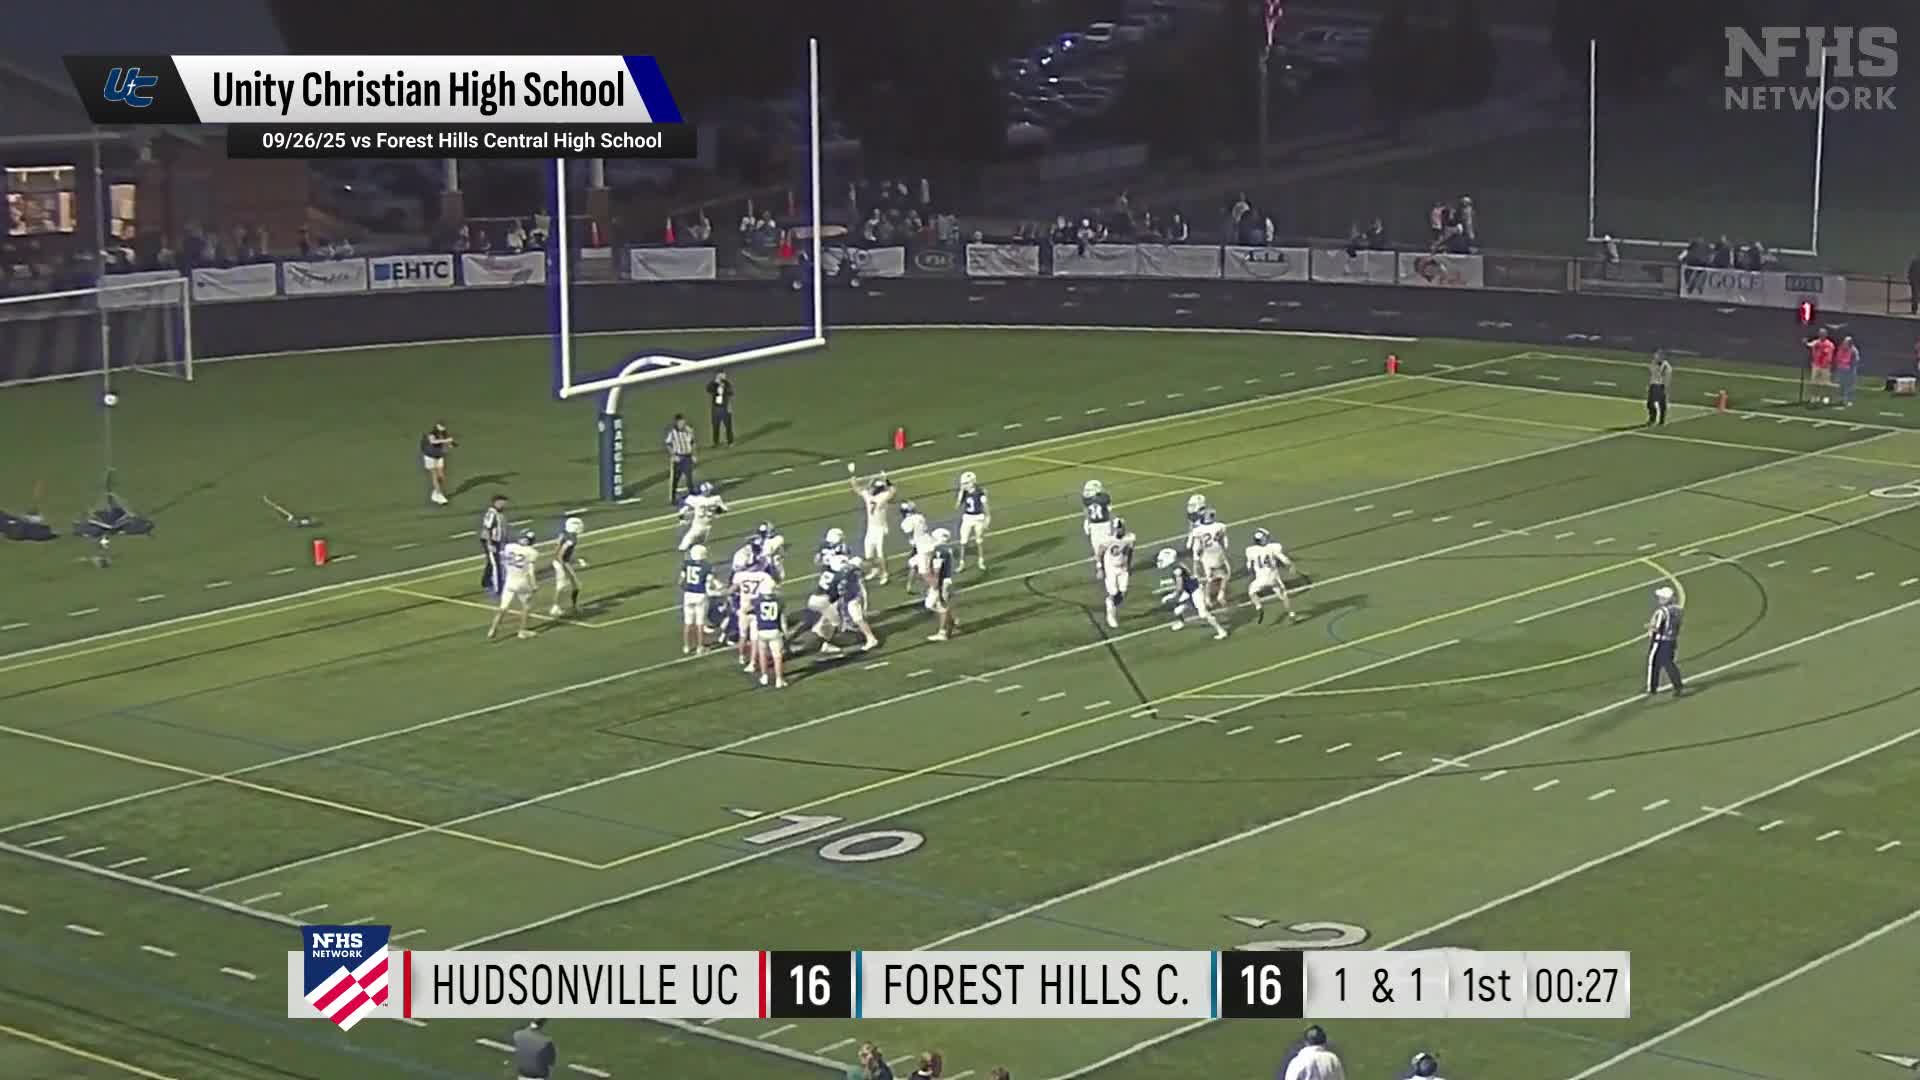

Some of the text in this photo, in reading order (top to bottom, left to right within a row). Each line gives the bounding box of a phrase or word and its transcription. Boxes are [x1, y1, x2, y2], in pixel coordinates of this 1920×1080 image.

[392, 261, 449, 280] EHTC
[686, 566, 702, 584] 15
[742, 579, 761, 595] 57
[743, 814, 926, 862] 10
